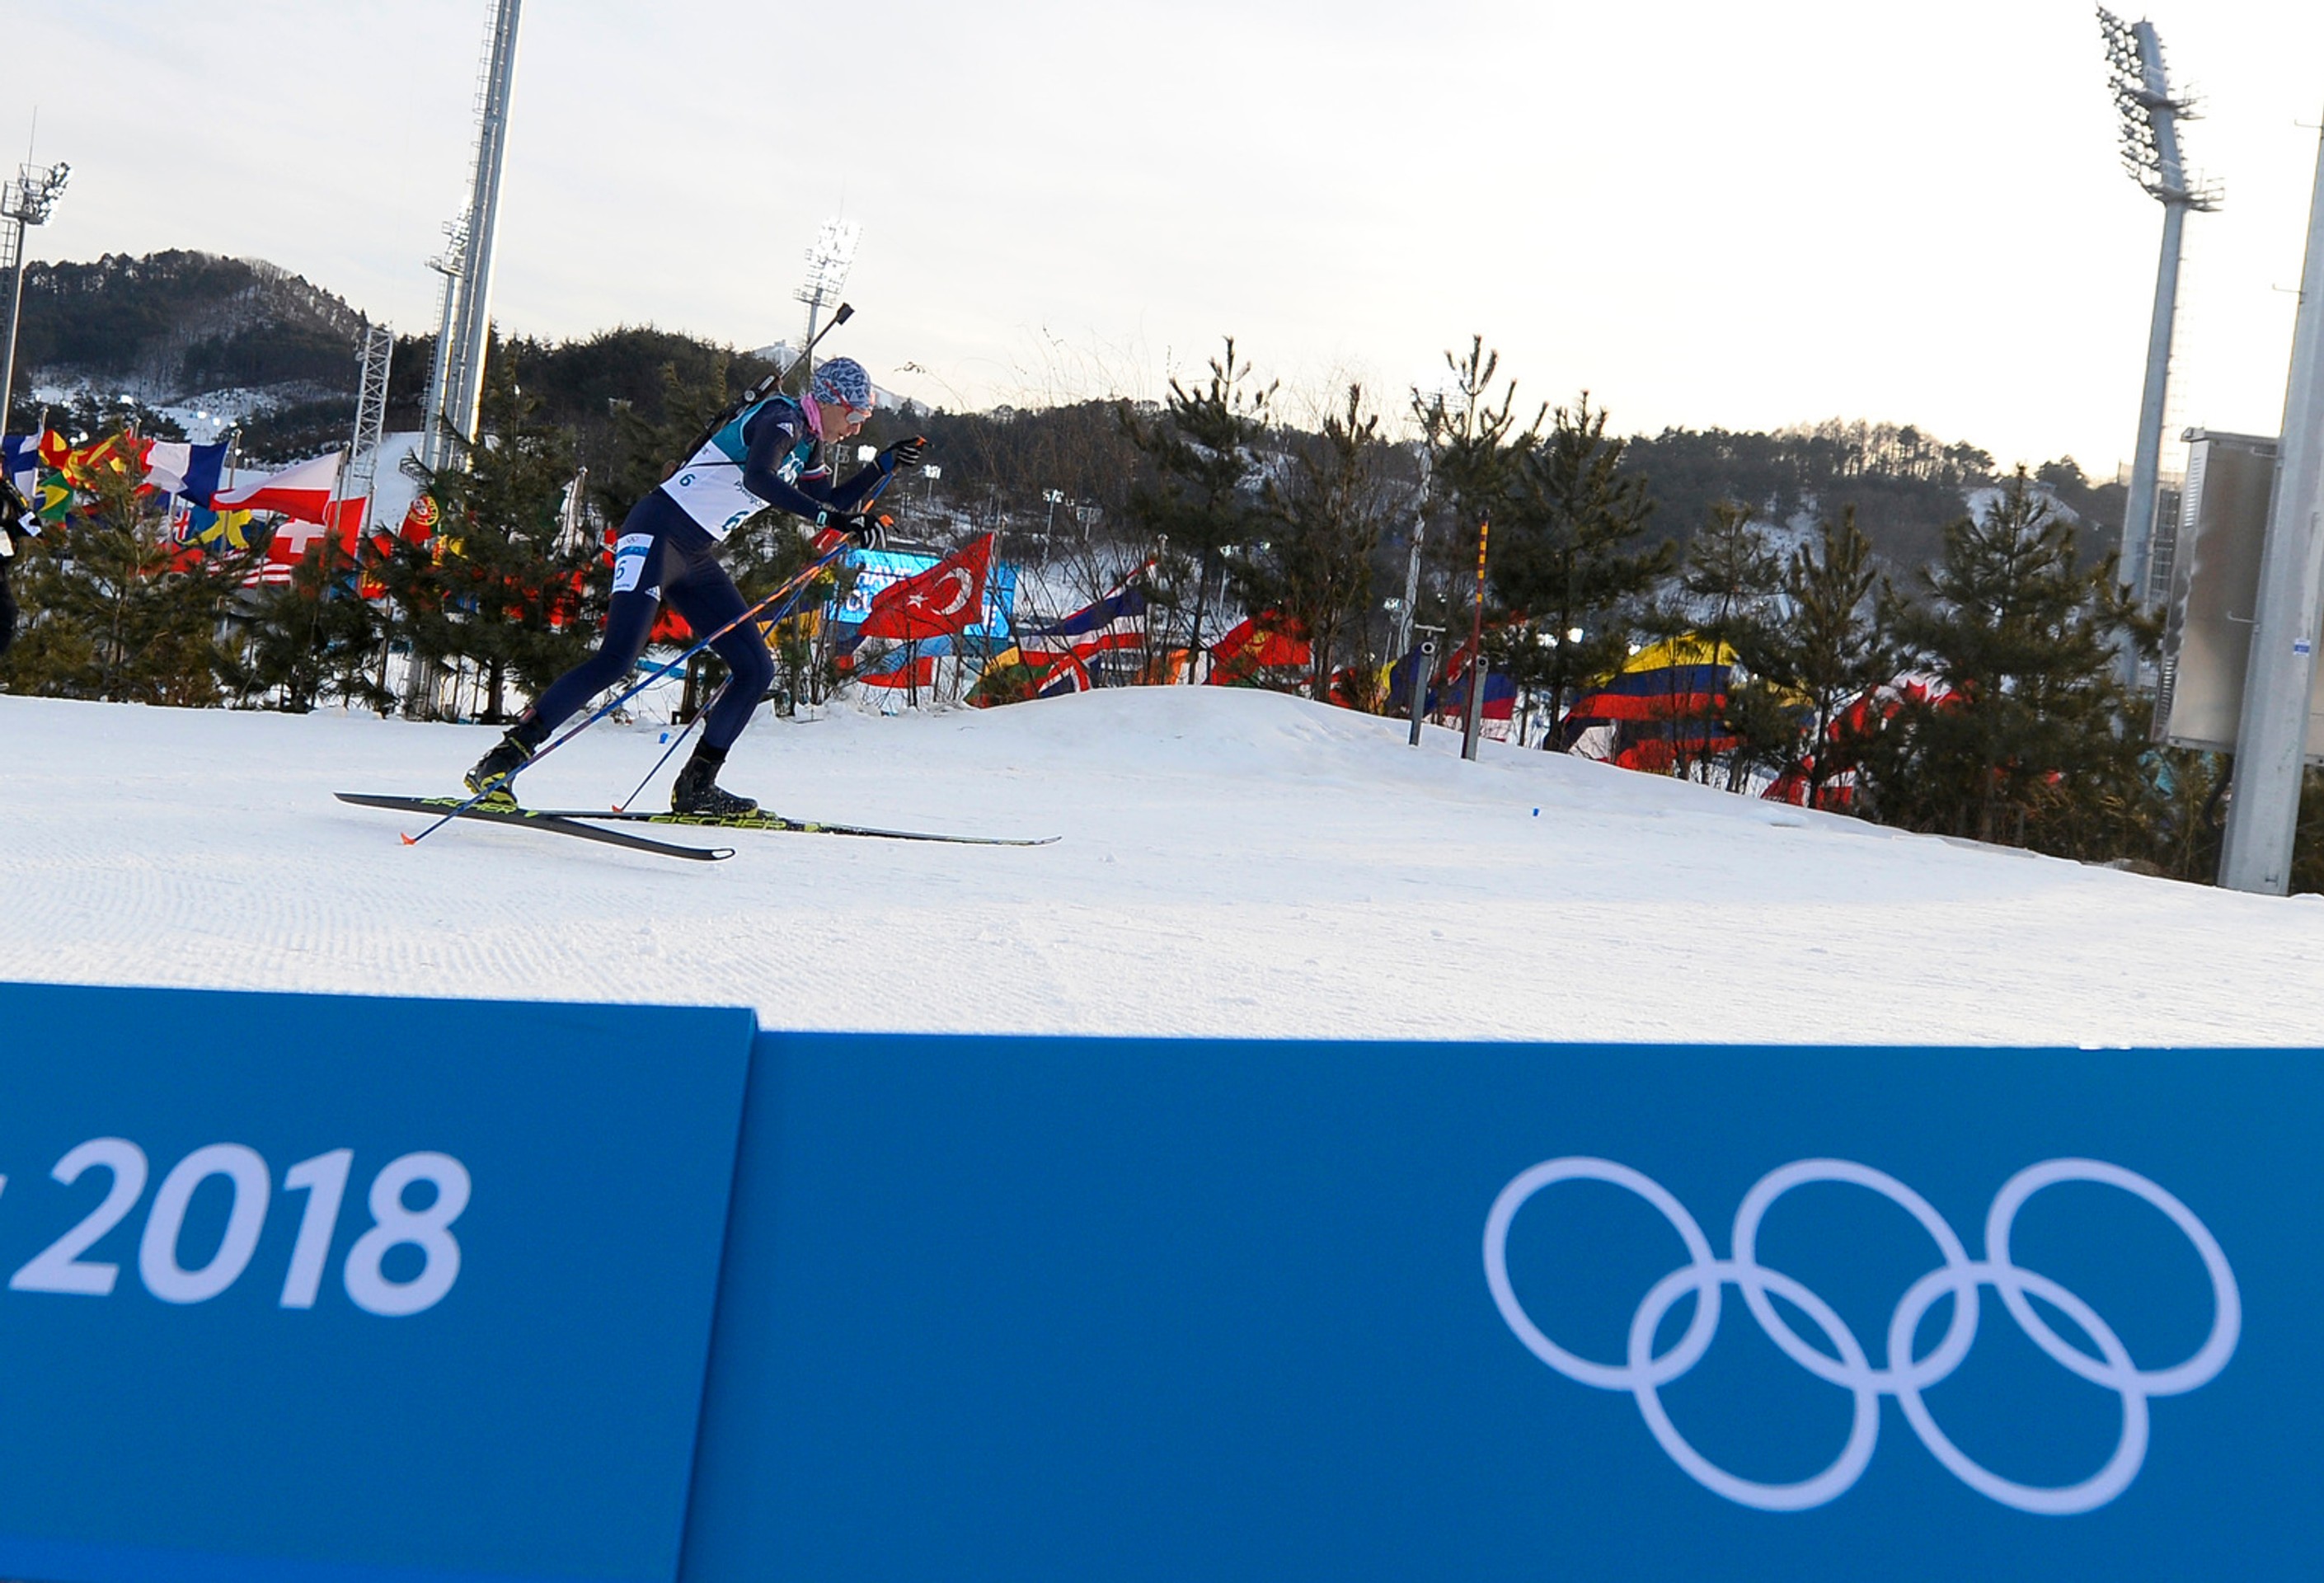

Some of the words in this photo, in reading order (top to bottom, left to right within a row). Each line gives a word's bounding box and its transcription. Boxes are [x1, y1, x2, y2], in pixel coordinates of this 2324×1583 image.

[679, 473, 696, 486] 6
[721, 510, 750, 533] 6
[648, 815, 787, 831] FISCHER
[8, 1136, 472, 1318] 2018
